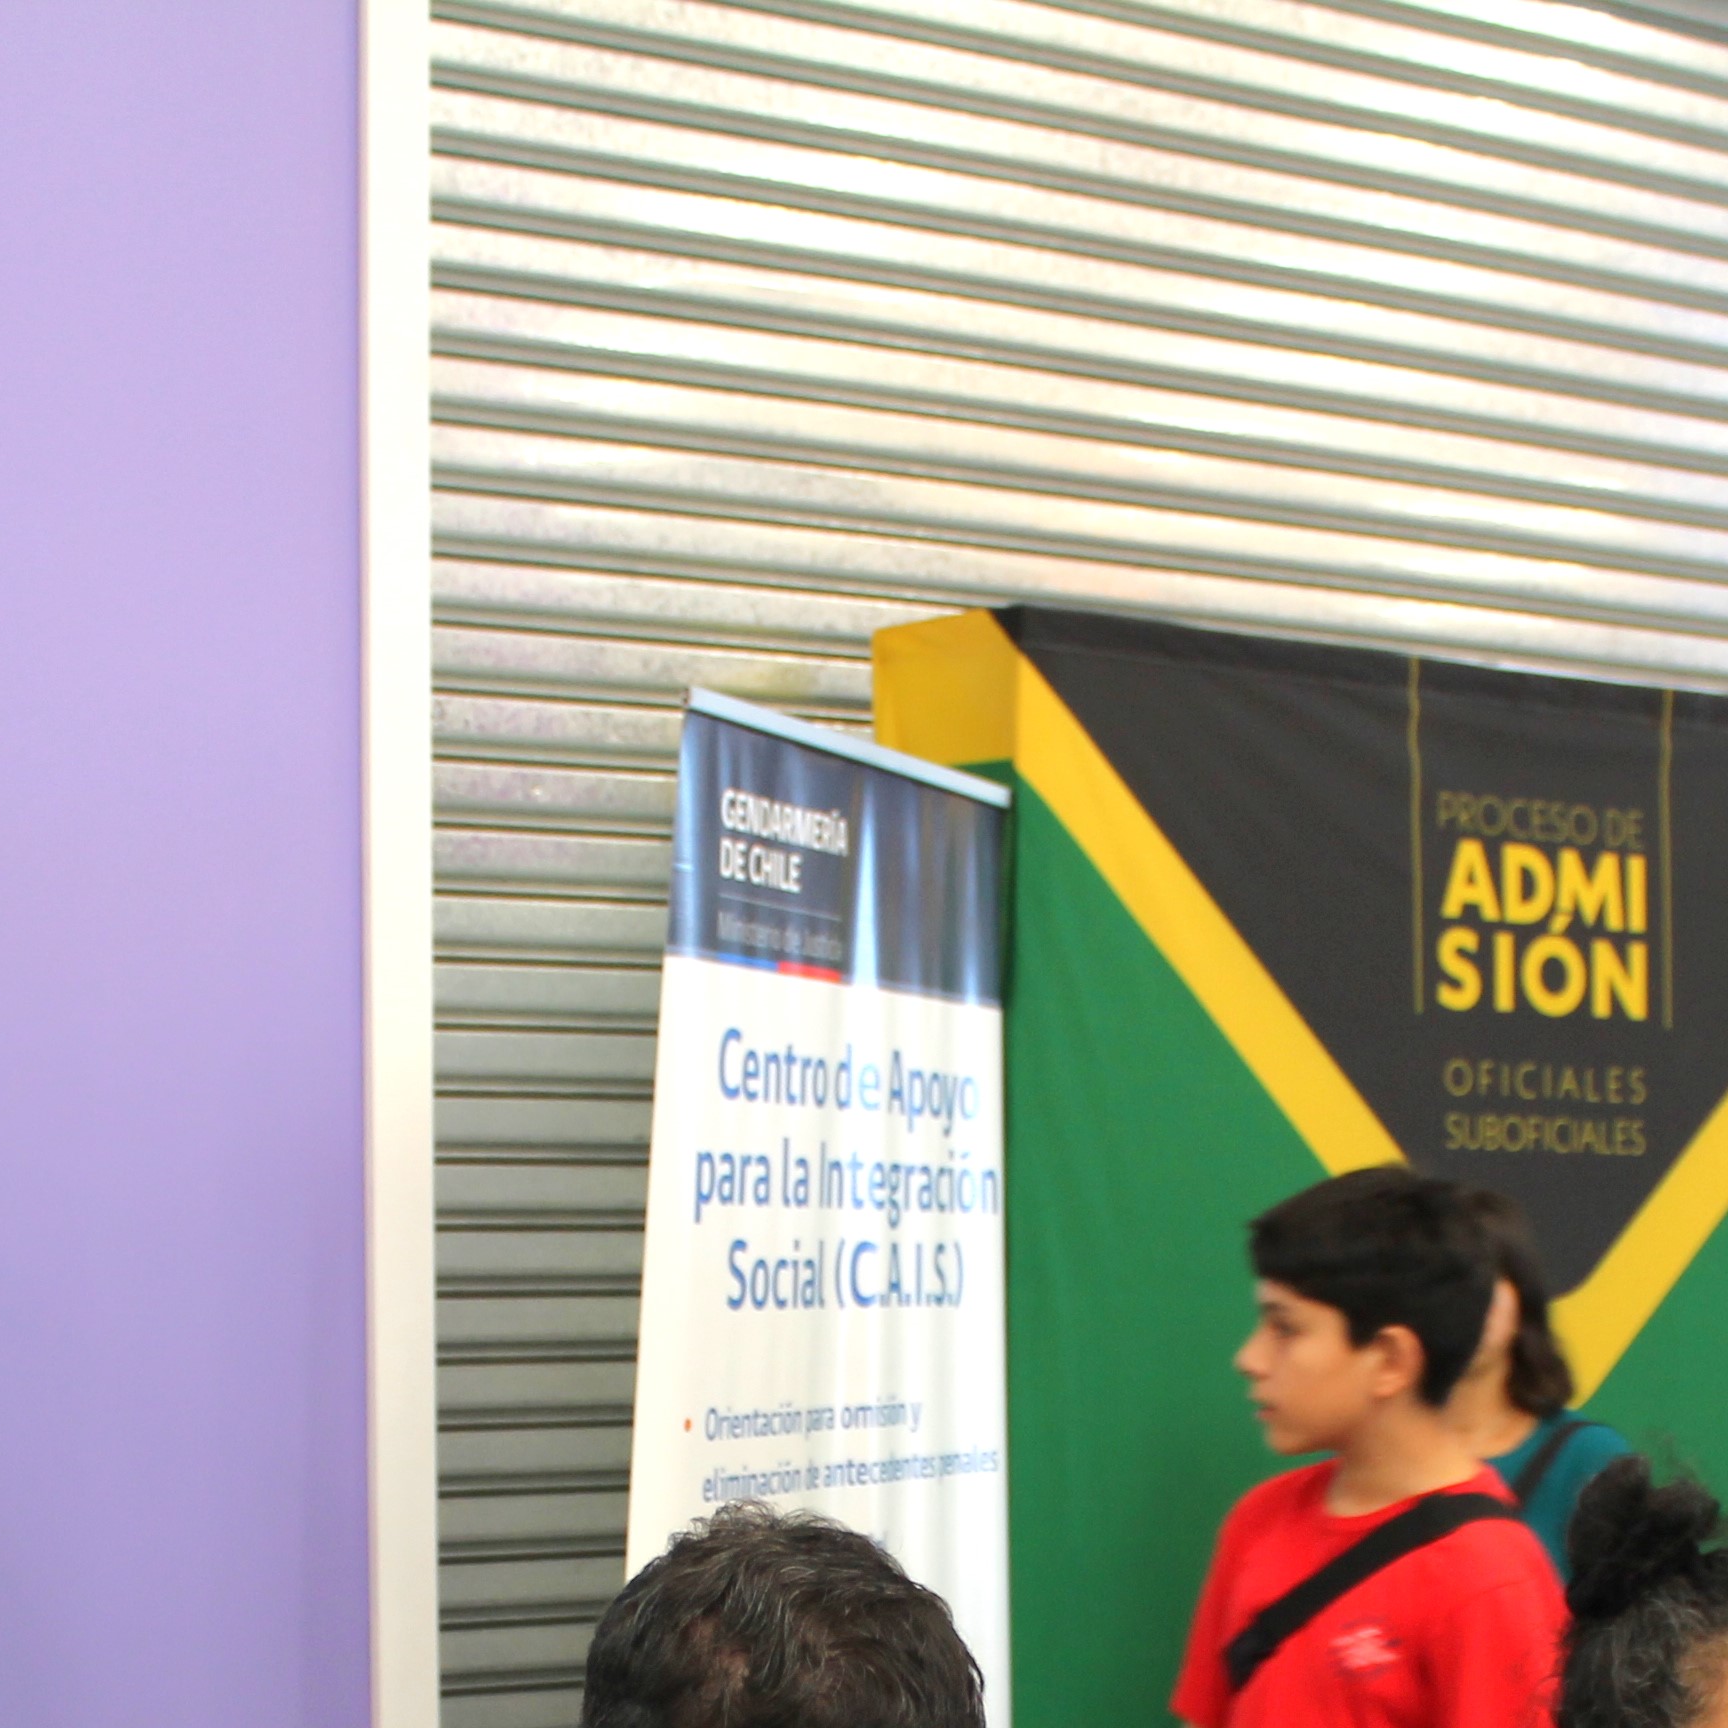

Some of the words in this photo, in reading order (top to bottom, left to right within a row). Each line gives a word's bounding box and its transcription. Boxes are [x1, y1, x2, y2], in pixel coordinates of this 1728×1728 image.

[721, 788, 849, 859] GENDARMERÍA
[1437, 791, 1598, 844] PROCESO
[1605, 807, 1645, 850] DE
[719, 836, 747, 882] DE
[748, 843, 802, 894] CHILE
[1440, 837, 1648, 934] ADMI
[1435, 911, 1649, 1023] SIÓN
[718, 1027, 826, 1108] Centro
[834, 1043, 882, 1110] de
[887, 1047, 980, 1137] Apoyo
[1443, 1057, 1647, 1106] OFICIALES
[1443, 1112, 1647, 1156] SUBOFICIALES
[694, 1149, 770, 1224] para
[782, 1138, 810, 1208] la
[819, 1140, 999, 1229] Integración
[726, 1238, 826, 1310] Social
[834, 1238, 965, 1311] (C.A.I.S.)
[704, 1402, 803, 1441] Orientación
[804, 1406, 835, 1440] para
[702, 1460, 802, 1502] eliminación
